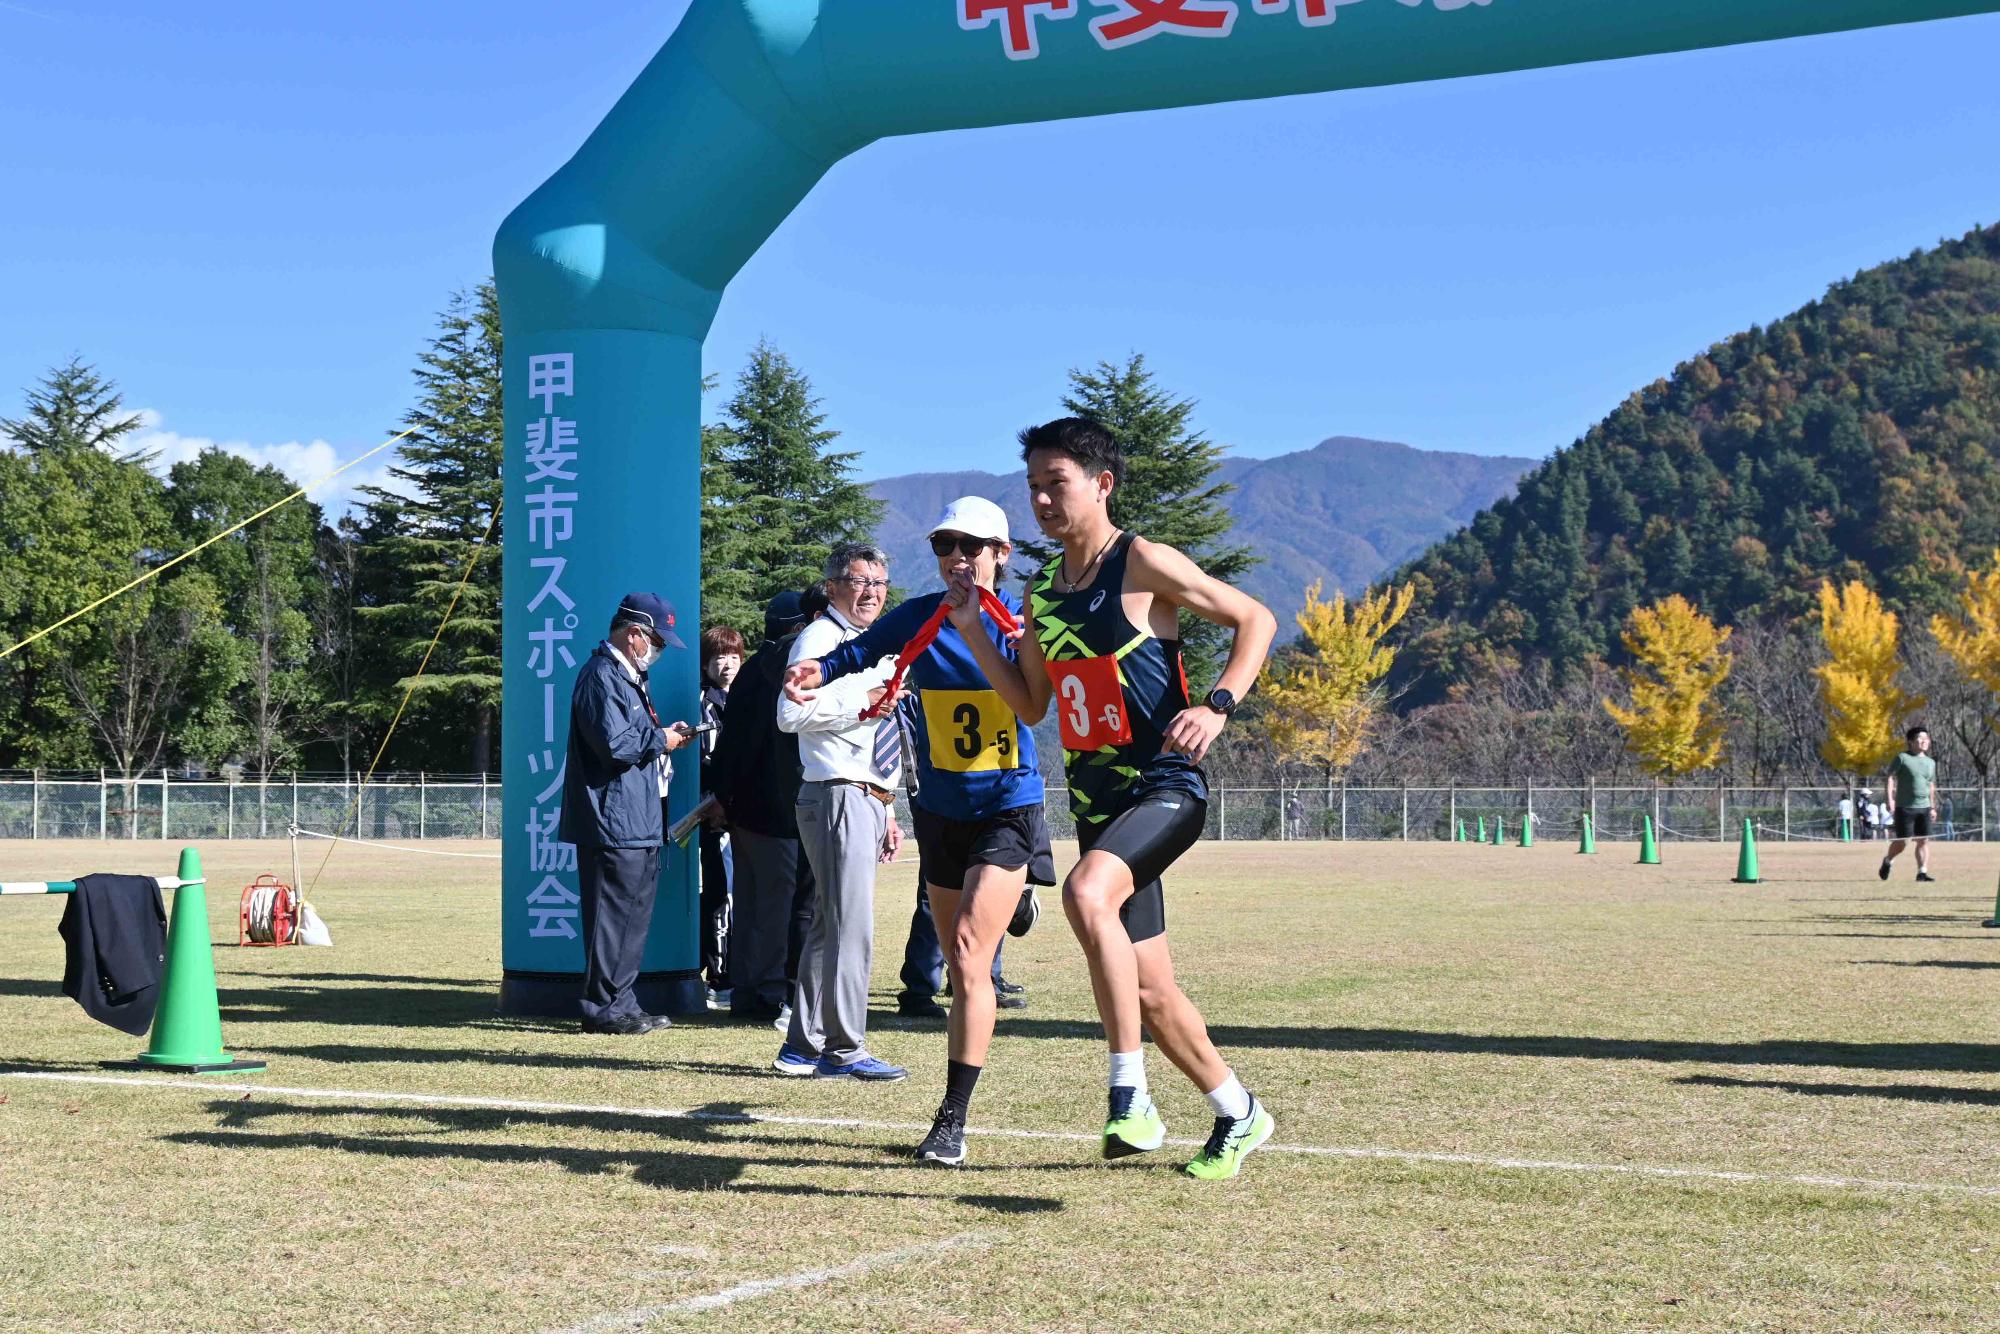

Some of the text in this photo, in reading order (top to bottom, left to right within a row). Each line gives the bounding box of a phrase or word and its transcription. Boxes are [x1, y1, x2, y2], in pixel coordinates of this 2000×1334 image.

[525, 352, 580, 939] 甲斐市スポーツ協会
